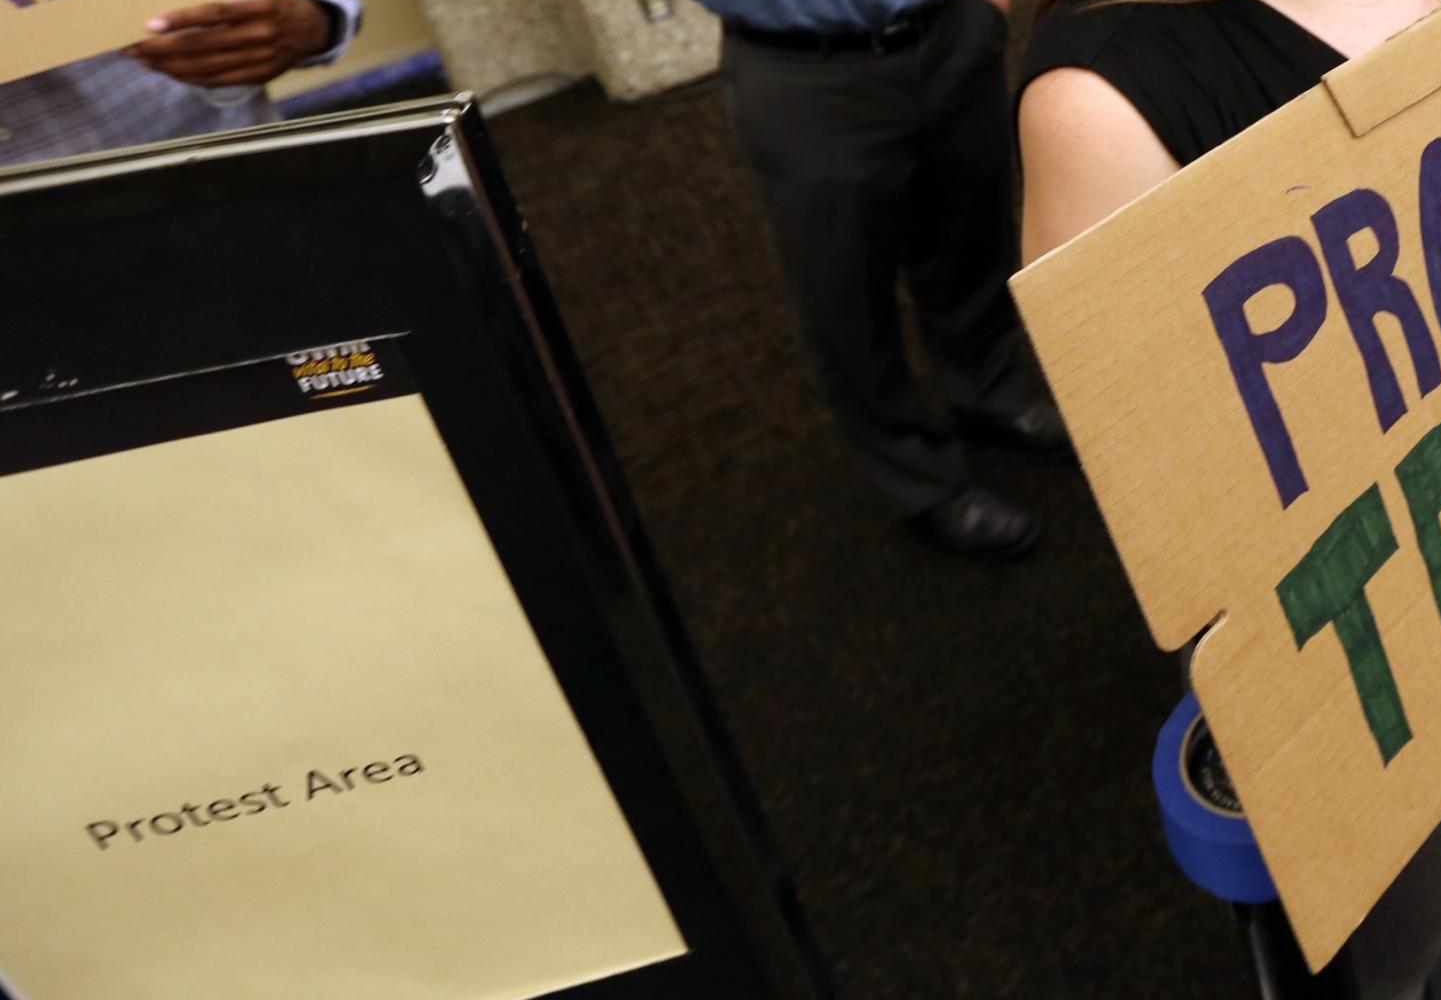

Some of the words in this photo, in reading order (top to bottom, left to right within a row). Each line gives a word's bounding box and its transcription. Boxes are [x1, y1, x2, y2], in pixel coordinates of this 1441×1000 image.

[297, 363, 385, 394] FUTURE
[84, 782, 291, 851] Protest
[304, 752, 425, 801] Area
